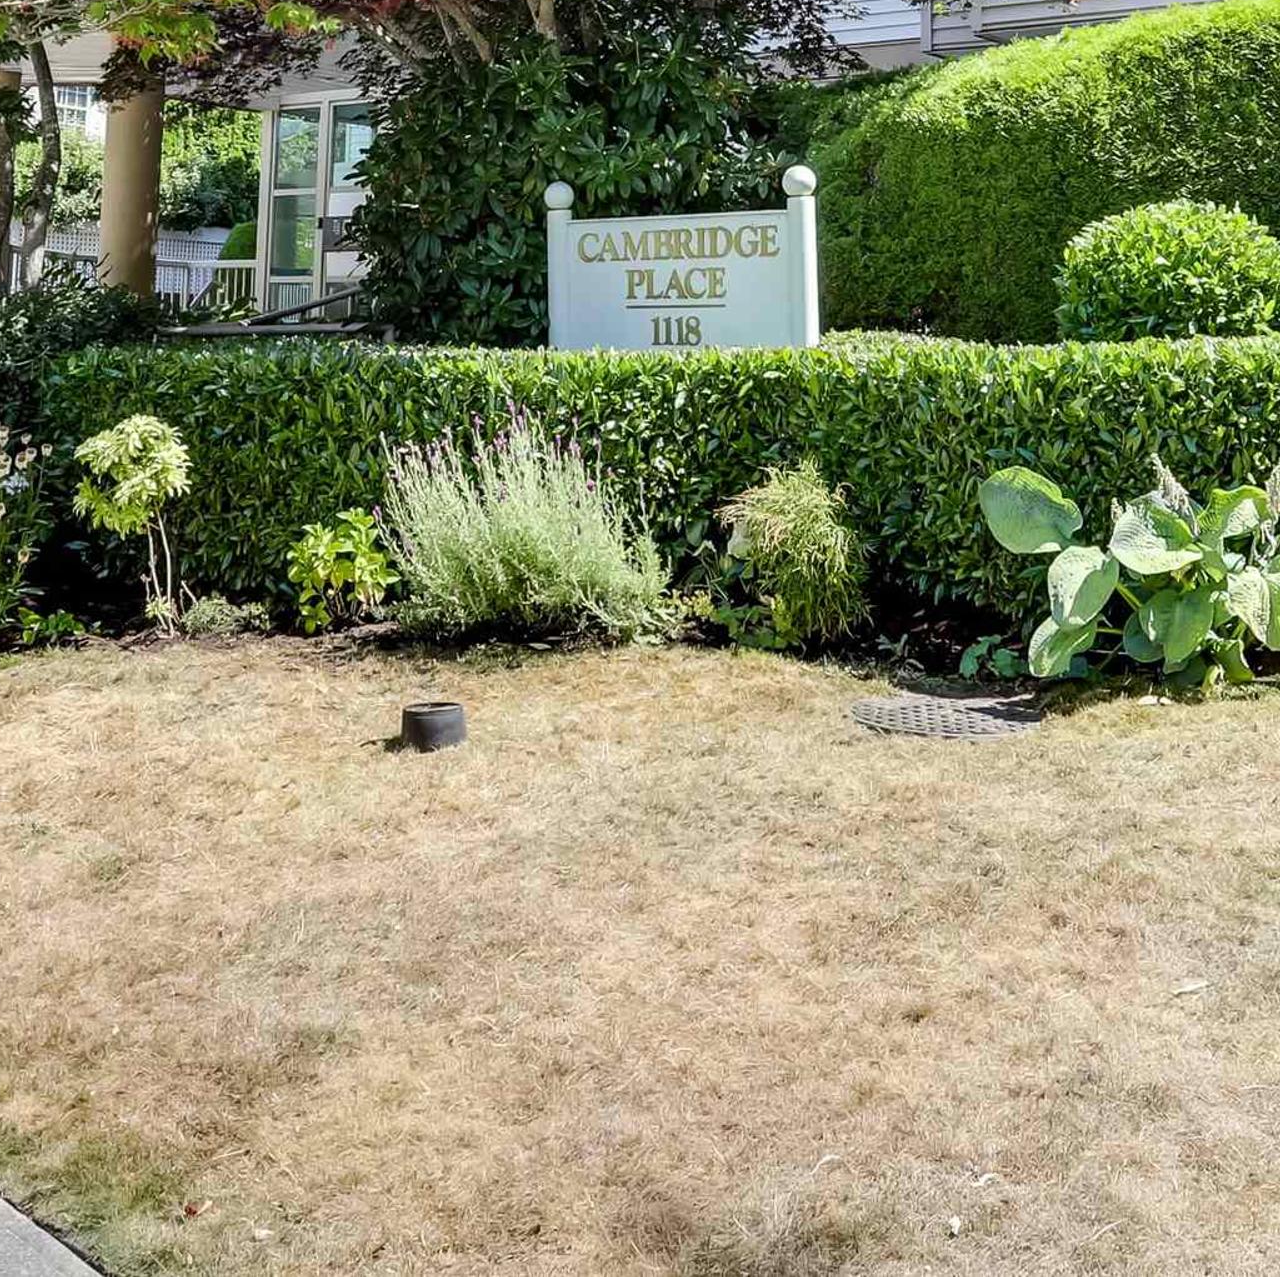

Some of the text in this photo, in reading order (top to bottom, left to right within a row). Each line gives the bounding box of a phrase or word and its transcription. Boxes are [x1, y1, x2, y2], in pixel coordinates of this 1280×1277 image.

[577, 225, 780, 263] CAMBRIDGE
[625, 267, 727, 300] PLACE
[650, 316, 702, 346] 1118
